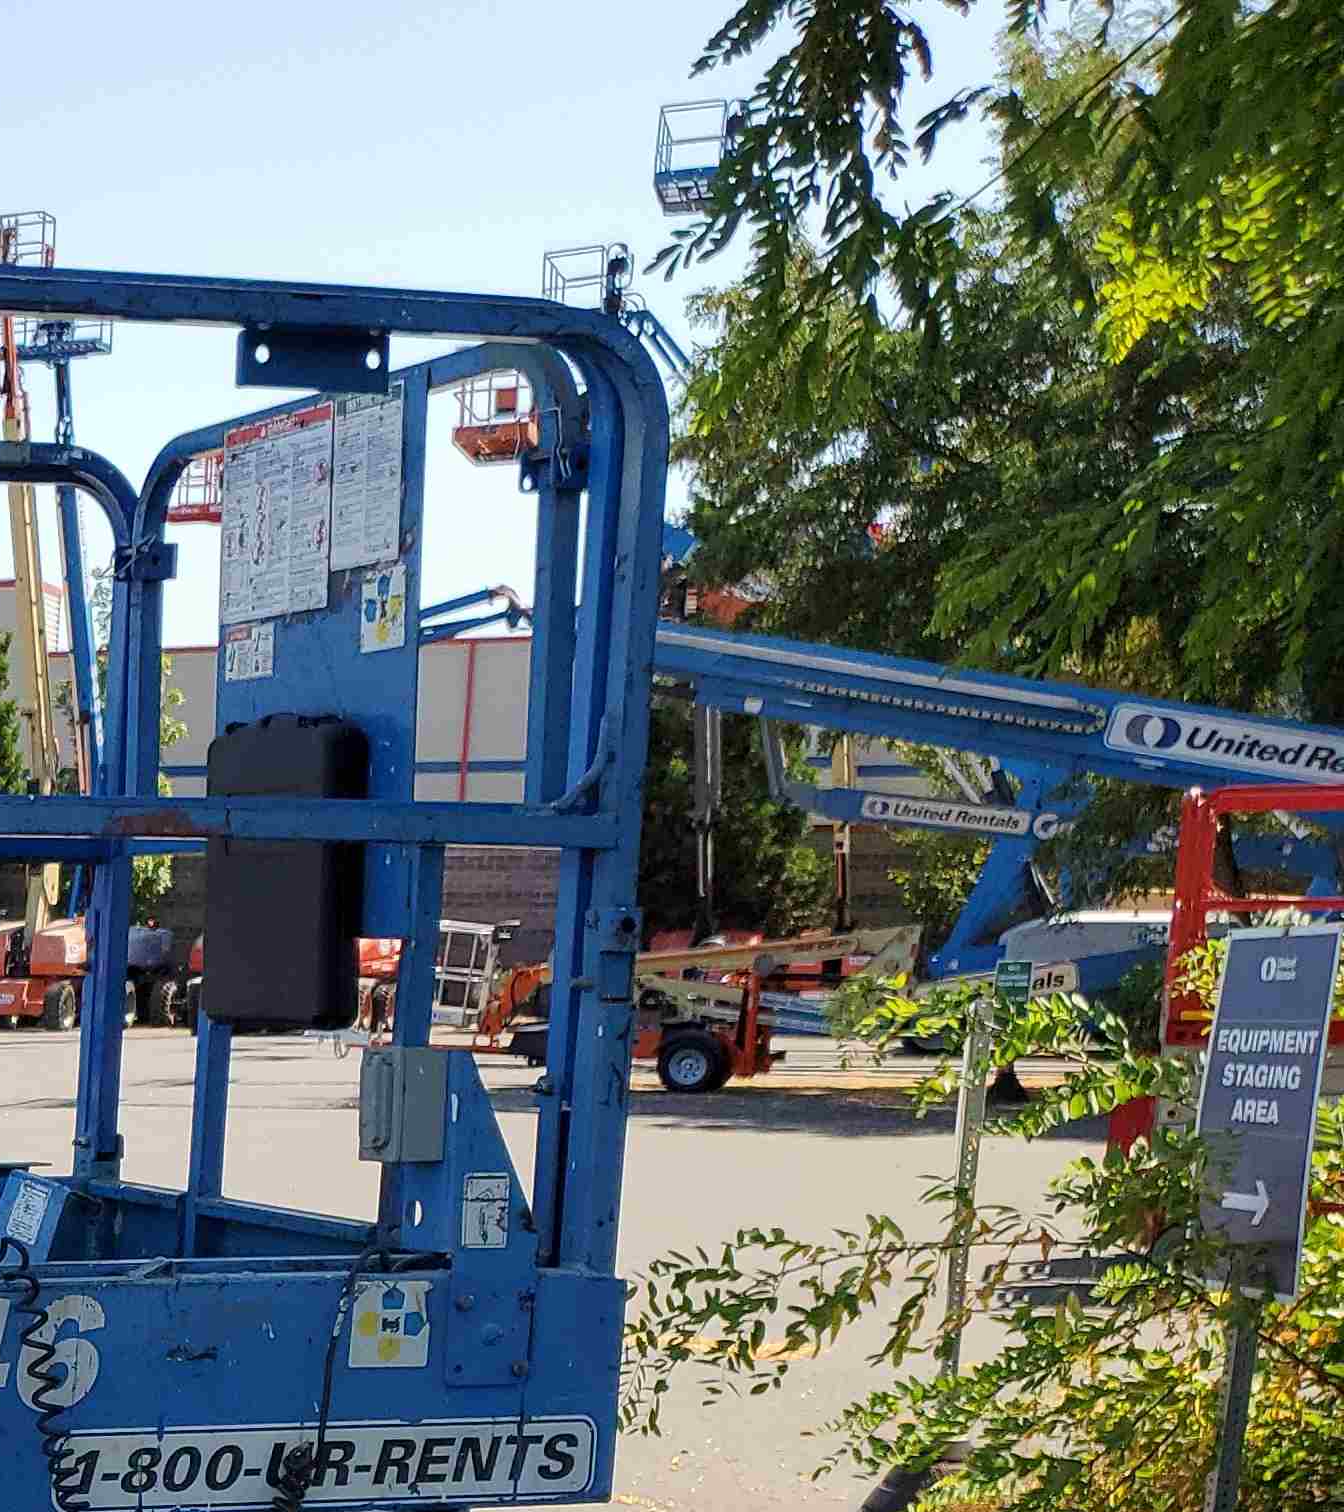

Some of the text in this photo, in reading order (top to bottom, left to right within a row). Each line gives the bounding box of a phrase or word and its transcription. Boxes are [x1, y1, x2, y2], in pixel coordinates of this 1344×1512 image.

[1186, 726, 1309, 765] United
[893, 802, 952, 821] United
[955, 811, 1020, 830] Rentals
[1216, 1028, 1320, 1056] EQUIPMENT
[1222, 1061, 1302, 1090] STAGING
[1231, 1098, 1279, 1125] AREA
